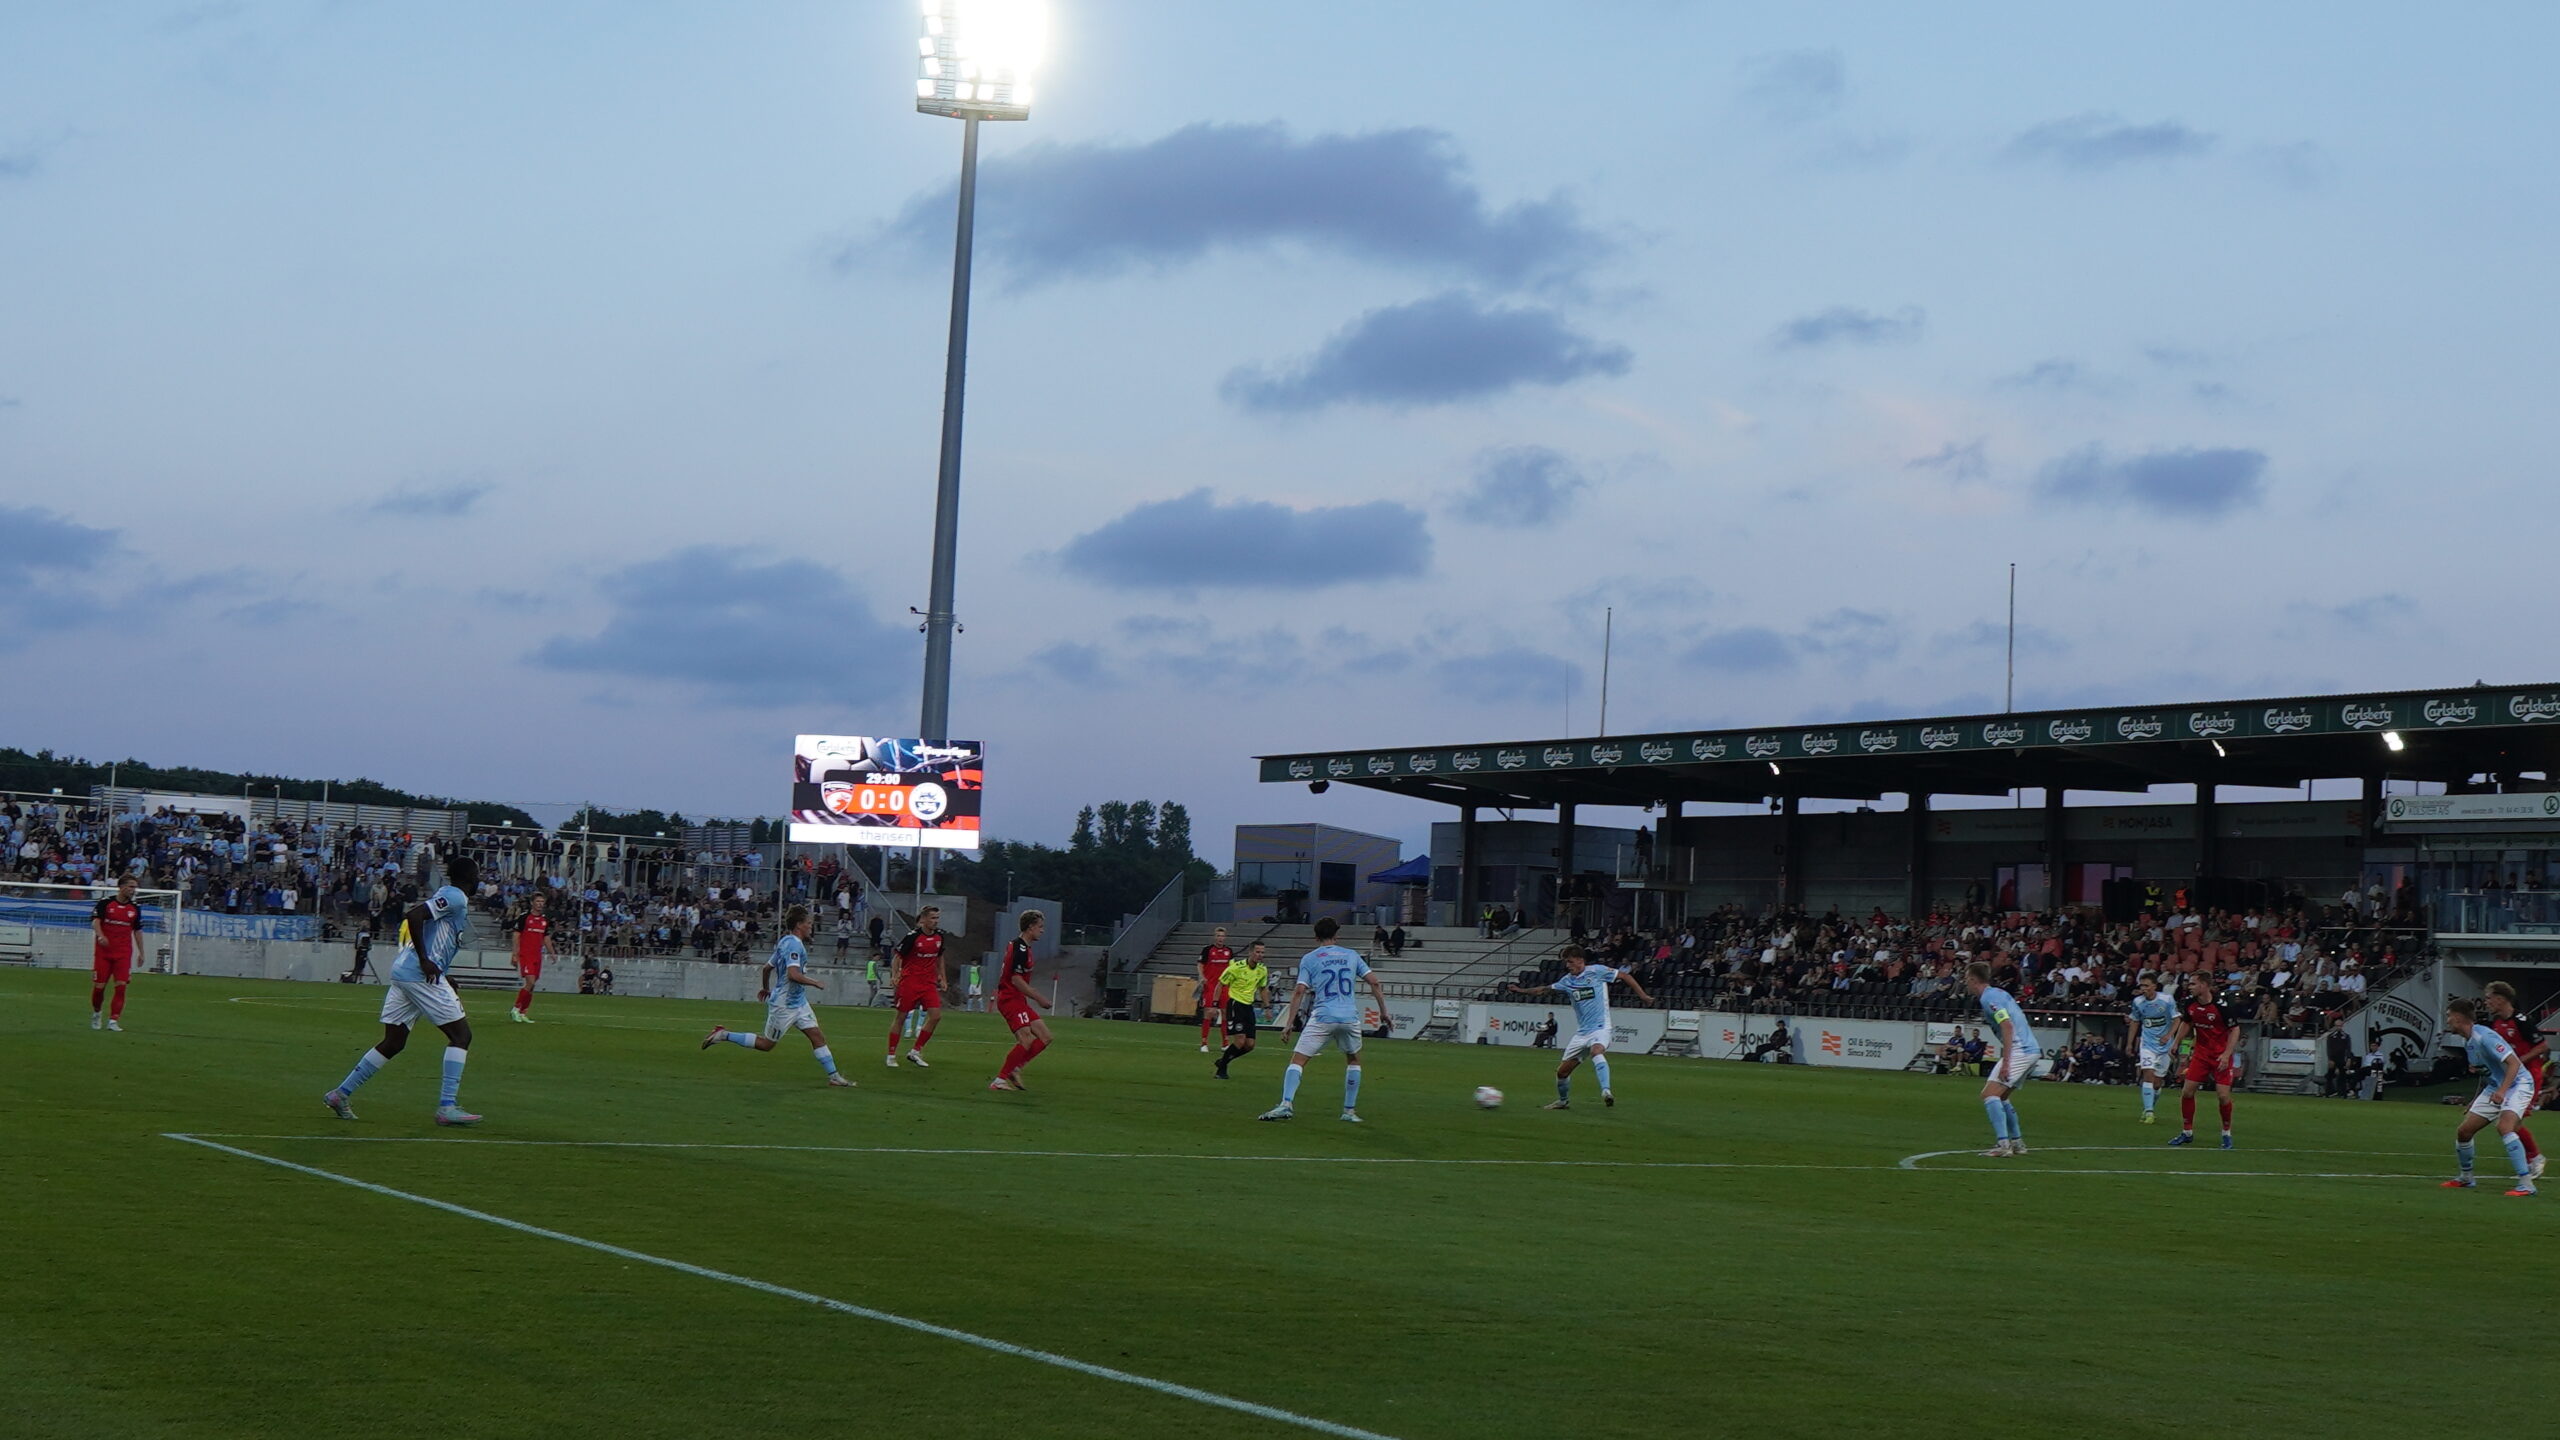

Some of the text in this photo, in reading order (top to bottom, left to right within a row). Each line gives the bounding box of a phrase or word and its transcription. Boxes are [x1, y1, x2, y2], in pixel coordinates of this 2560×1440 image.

[2264, 708, 2312, 733] Carlsberg
[2341, 703, 2393, 730] Carlsberg
[2424, 699, 2477, 726] Carlsberg
[2049, 719, 2092, 743] Carlsberg
[2117, 716, 2163, 740] Carlsberg
[2189, 712, 2236, 737] Carlsberg
[1801, 733, 1839, 755] Carlsberg
[1859, 730, 1899, 752] Carlsberg
[1920, 727, 1960, 749] Carlsberg
[1983, 723, 2024, 746] Carlsberg
[1591, 745, 1623, 764] Carlsberg
[1640, 742, 1674, 762] Carlsberg
[1692, 739, 1727, 760] Carlsberg
[1745, 736, 1782, 758] Carlsberg
[1368, 757, 1395, 775] Carlsberg
[1409, 754, 1437, 773] Carlsberg
[1453, 752, 1482, 771] Carlsberg
[1497, 750, 1527, 769] Carlsberg
[1543, 748, 1574, 767] Carlsberg
[1289, 761, 1314, 778] Carlsberg
[1328, 759, 1353, 776] Carlsberg
[866, 772, 900, 784] 29:00
[860, 830, 912, 842] thansen
[1322, 967, 1352, 996] 26
[1017, 1011, 1030, 1024] 13
[2378, 1003, 2387, 1014] FC
[1848, 1038, 1857, 1046] Oil
[1865, 1039, 1893, 1051] Shipping
[1848, 1048, 1882, 1057] Since 2002
